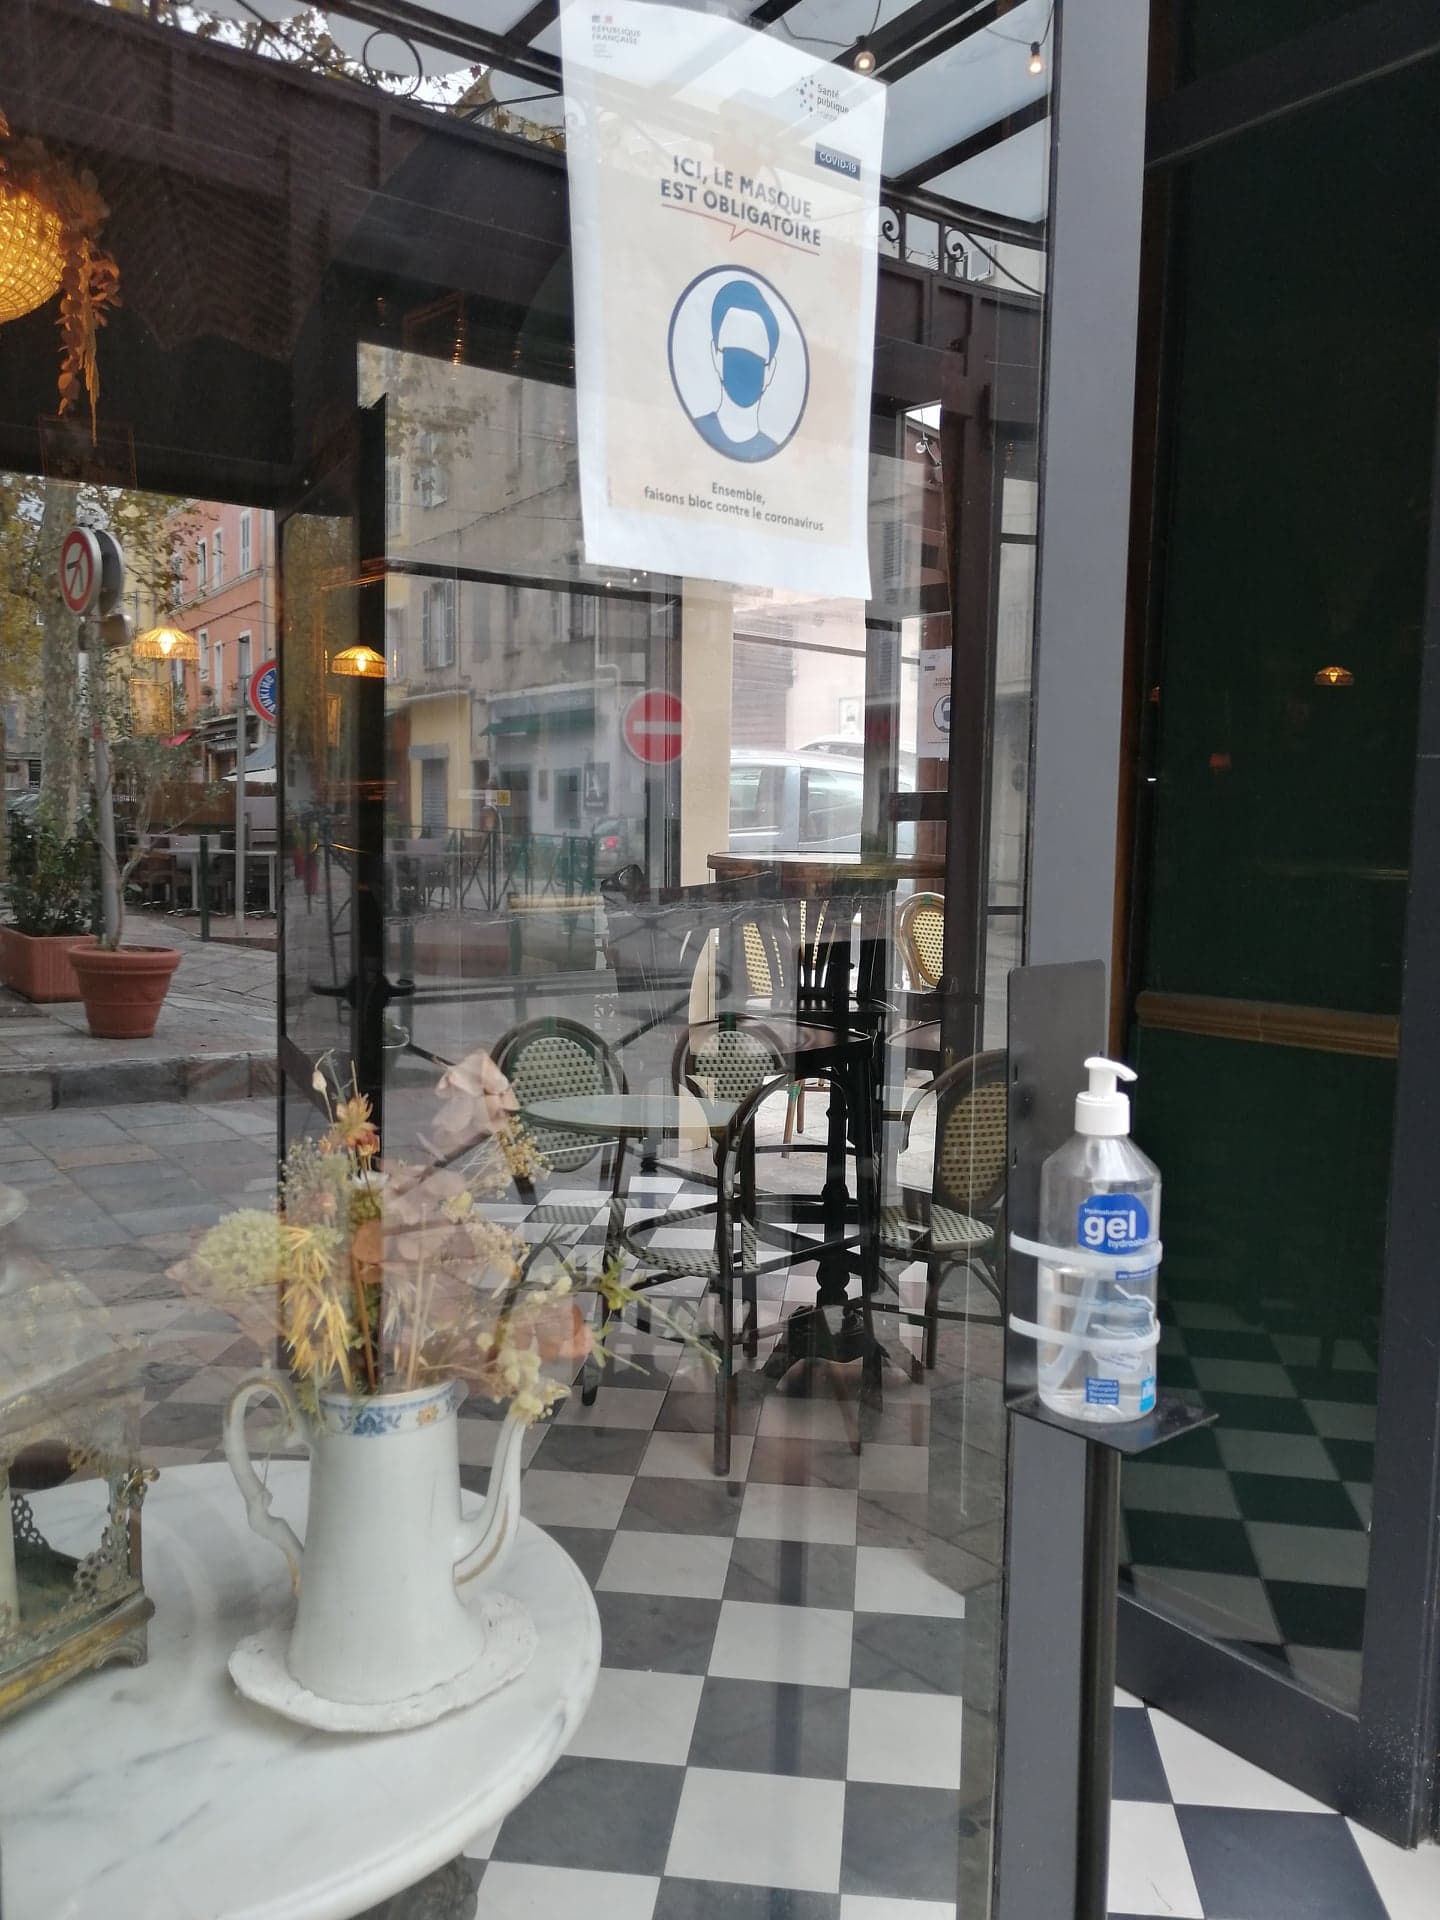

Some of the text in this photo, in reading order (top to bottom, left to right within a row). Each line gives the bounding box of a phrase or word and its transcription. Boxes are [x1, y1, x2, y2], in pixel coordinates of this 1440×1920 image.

[818, 83, 840, 98] Santé
[817, 97, 849, 115] publique
[819, 151, 857, 173] COVID-19
[674, 155, 811, 219] ICI, LE MASQUE
[661, 178, 821, 247] EST OBLIGATOIRE
[711, 481, 766, 505] Ensemble,
[644, 486, 824, 532] faisons bloc contre le coronavirus
[1084, 1209, 1137, 1246] gel
